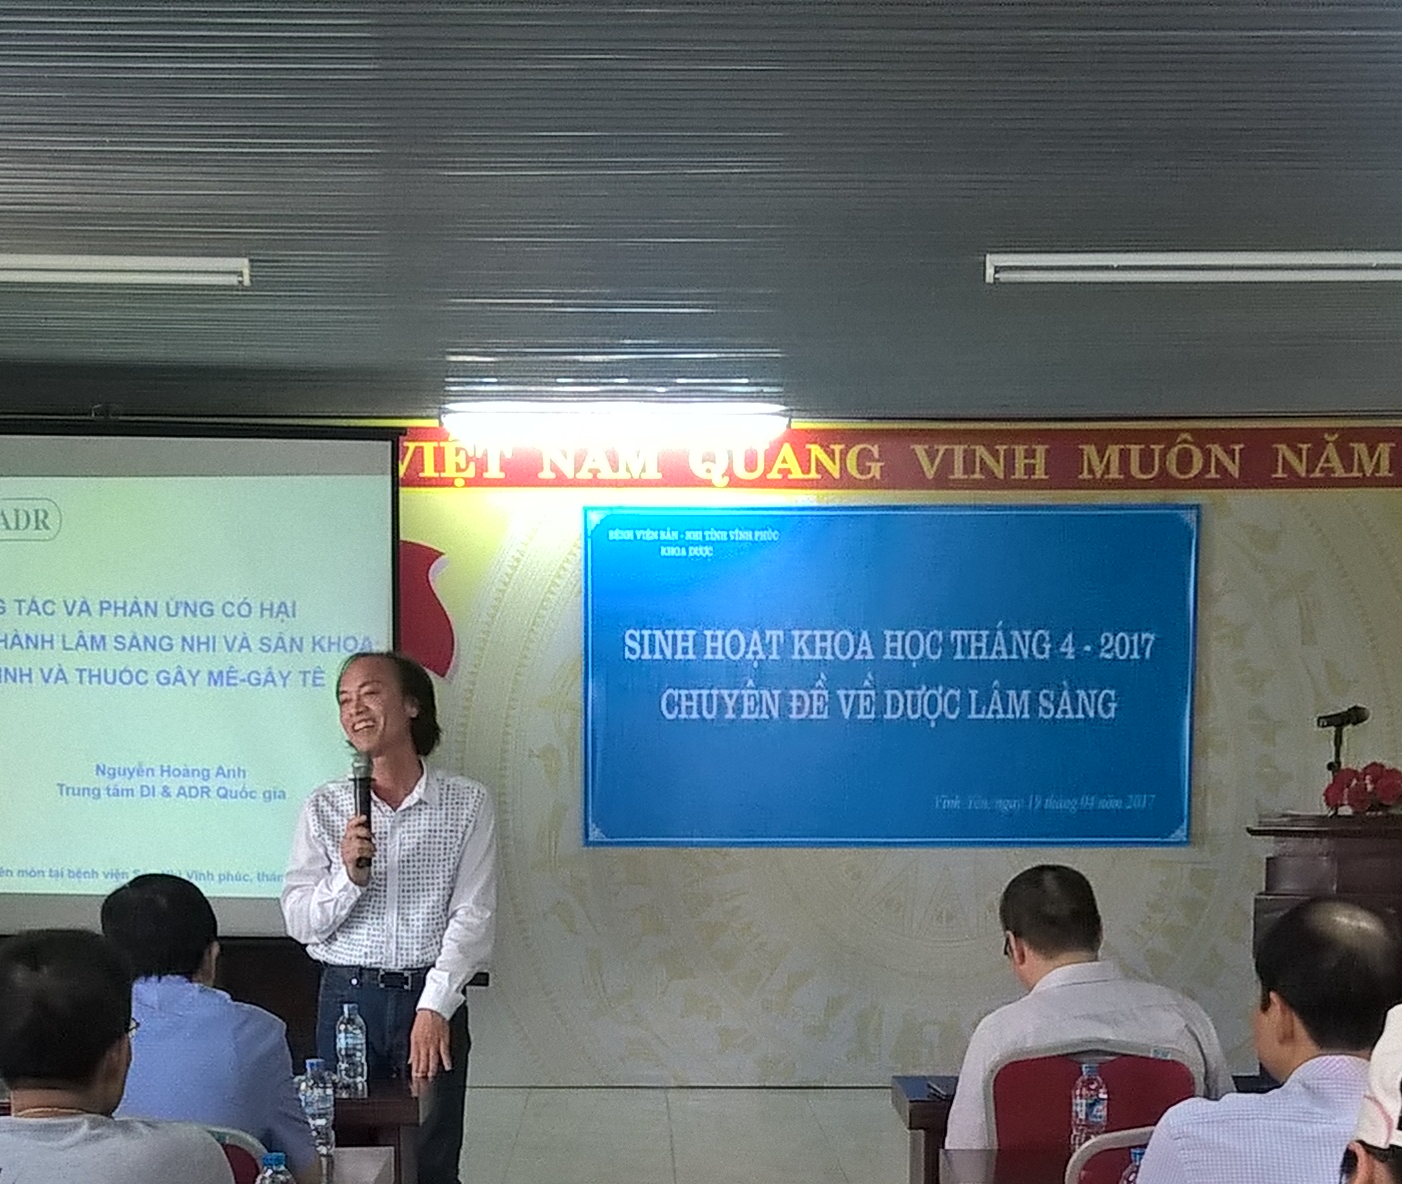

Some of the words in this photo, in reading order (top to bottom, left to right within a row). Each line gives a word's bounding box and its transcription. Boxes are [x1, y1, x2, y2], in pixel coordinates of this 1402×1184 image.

[538, 446, 663, 480] NAM
[688, 441, 885, 487] QUANG
[910, 443, 1050, 481] VINH
[1078, 432, 1245, 480] MUÔN
[1272, 432, 1396, 478] NĂM
[660, 546, 686, 556] KHOA
[14, 596, 56, 616] TÁC
[64, 596, 92, 617] VÀ
[222, 596, 253, 618] CÓ
[259, 599, 297, 623] HẠI
[62, 630, 107, 652] LÂM
[113, 629, 174, 652] SÀNG
[181, 635, 216, 653] NHI
[223, 632, 253, 653] VÀ
[311, 635, 374, 653] KHOA
[624, 629, 697, 661] SINH
[703, 629, 785, 668] HOẠT
[791, 629, 875, 661] KHOA
[883, 629, 943, 668] HỌC
[950, 620, 1052, 660] THÁNG
[1059, 631, 1076, 660] 4
[1099, 631, 1156, 660] 2017
[40, 664, 69, 685] VÀ
[155, 666, 200, 687] GÂY
[208, 666, 291, 688] MÊ-GÂY
[299, 666, 326, 688] TÊ
[660, 678, 782, 720] CHUYÊN
[789, 671, 829, 720] ĐỀ
[837, 671, 876, 720] VỀ
[883, 685, 961, 728] DƯỢC
[968, 680, 1031, 719] LÂM
[1038, 680, 1118, 720] SÀNG
[160, 765, 211, 781] Hoàng
[215, 765, 247, 779] Anh
[56, 783, 101, 799] Trung
[106, 784, 135, 798] tâm
[140, 785, 156, 798] DI
[160, 785, 172, 798] &
[176, 785, 212, 799] ADR
[216, 785, 258, 800] Quốc
[262, 787, 287, 803] gia
[257, 871, 284, 883] thán
